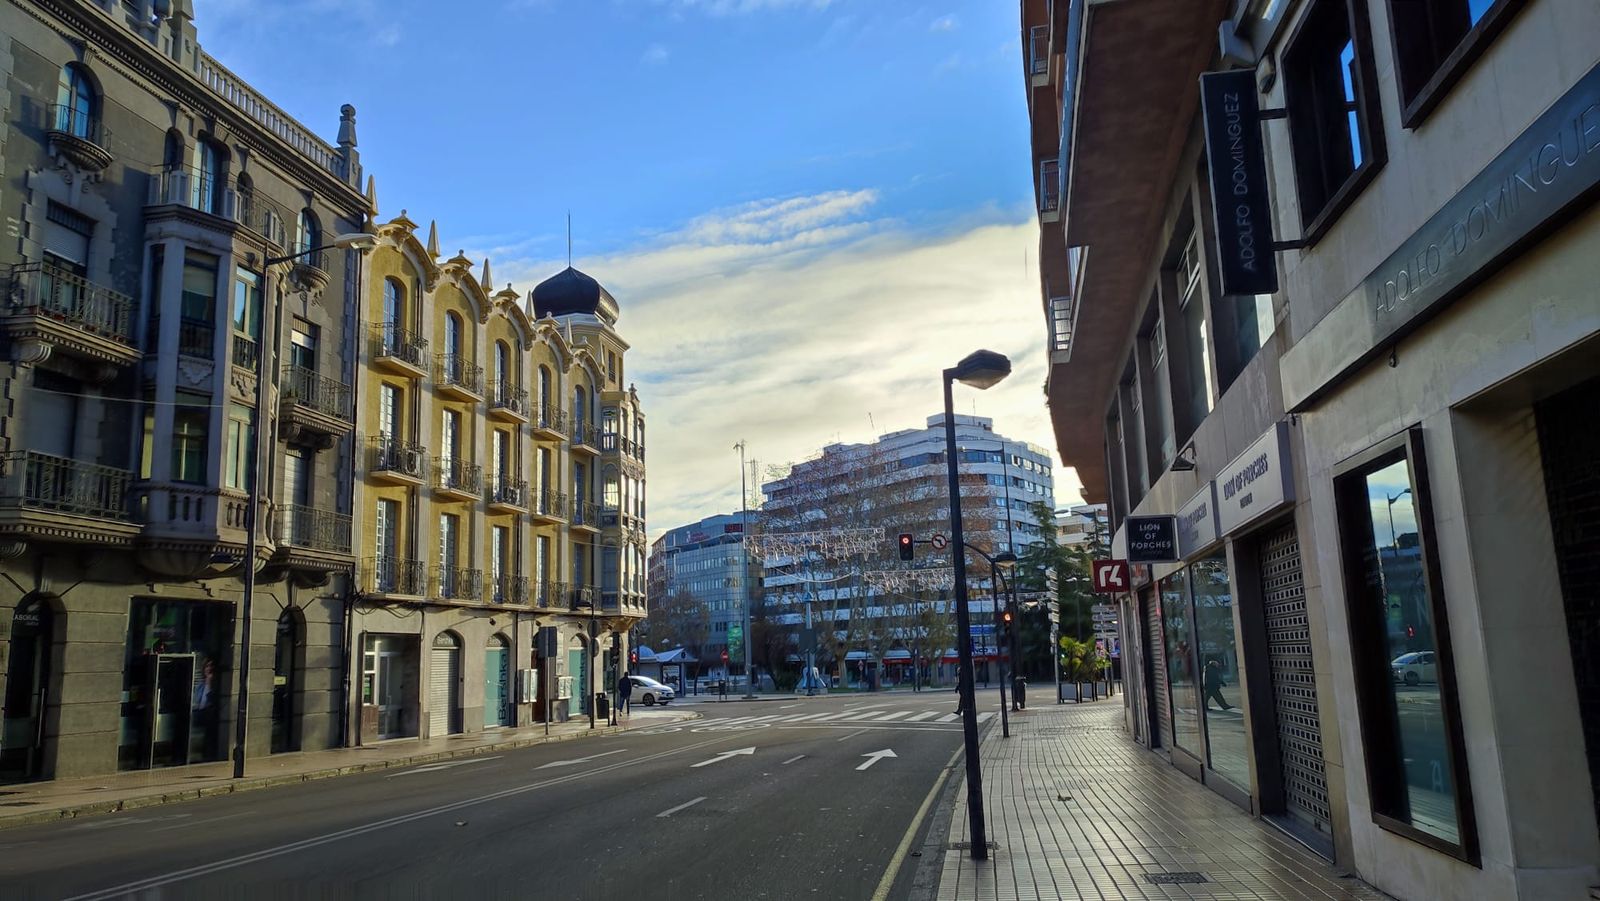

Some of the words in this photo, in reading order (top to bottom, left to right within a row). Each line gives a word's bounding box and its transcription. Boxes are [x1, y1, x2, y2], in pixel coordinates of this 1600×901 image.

[1224, 92, 1249, 195] DOMINGUEZ
[1236, 205, 1256, 271] ADOLFO
[1375, 243, 1441, 322] ADOLFO
[1451, 103, 1600, 257] DOMINGUE
[1131, 541, 1172, 549] PORCHES
[1139, 523, 1160, 531] LION
